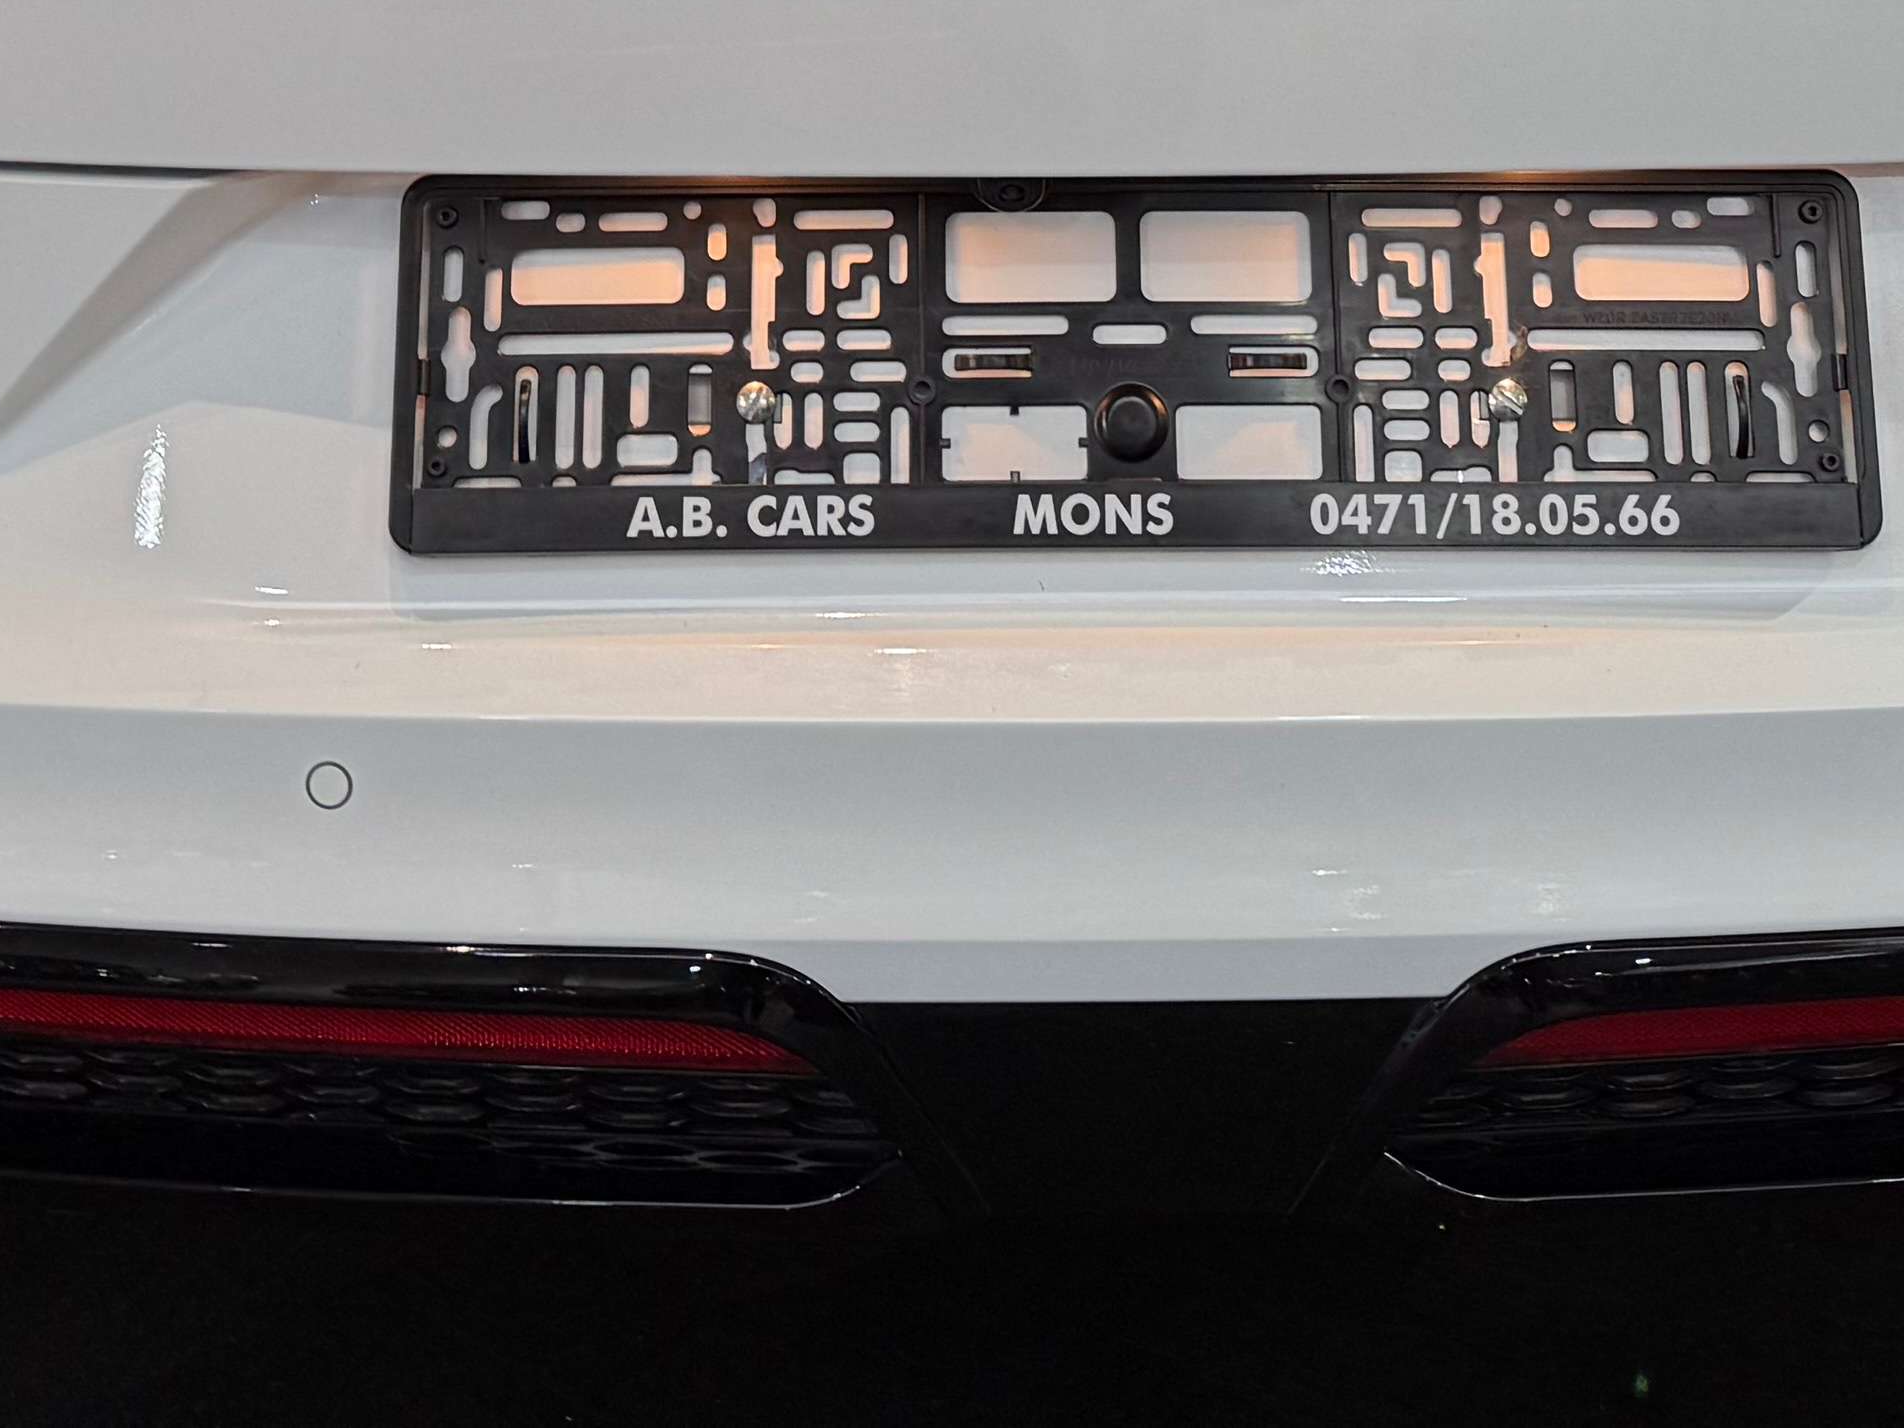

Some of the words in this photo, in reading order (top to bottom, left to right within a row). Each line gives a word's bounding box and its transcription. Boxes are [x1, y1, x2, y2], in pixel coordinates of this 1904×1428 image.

[626, 496, 728, 539] A.B.
[747, 493, 875, 538] CARS
[1013, 492, 1174, 536] MONS
[1309, 492, 1681, 540] 0471/18.05.66
